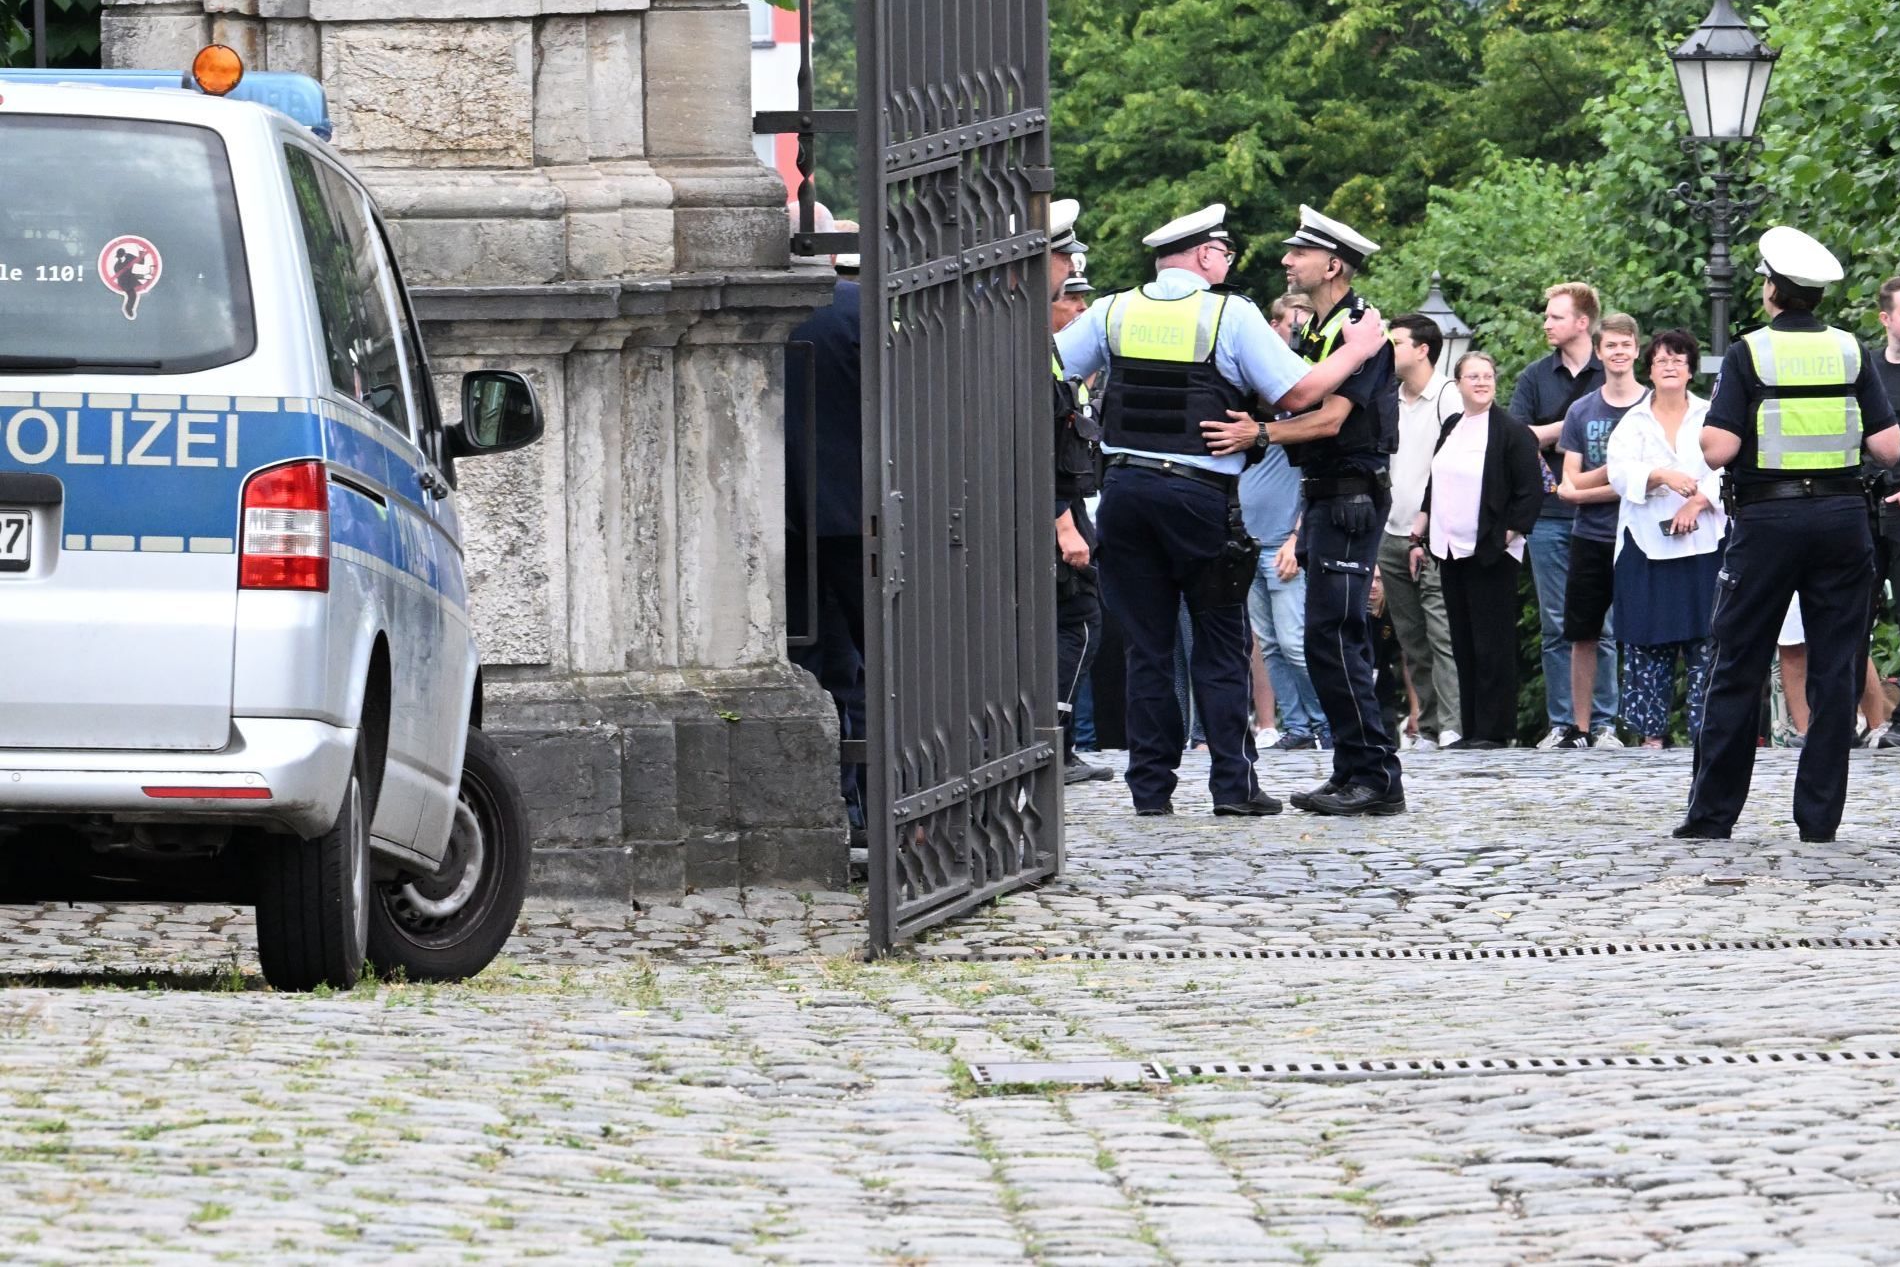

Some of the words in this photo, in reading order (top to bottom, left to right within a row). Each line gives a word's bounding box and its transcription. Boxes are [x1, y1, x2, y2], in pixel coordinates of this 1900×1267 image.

[36, 265, 84, 282] 110!
[1129, 323, 1185, 346] POLIZEI
[1779, 355, 1842, 377] POLIZEI
[0, 408, 238, 468] OLIZEI
[0, 518, 24, 554] 7
